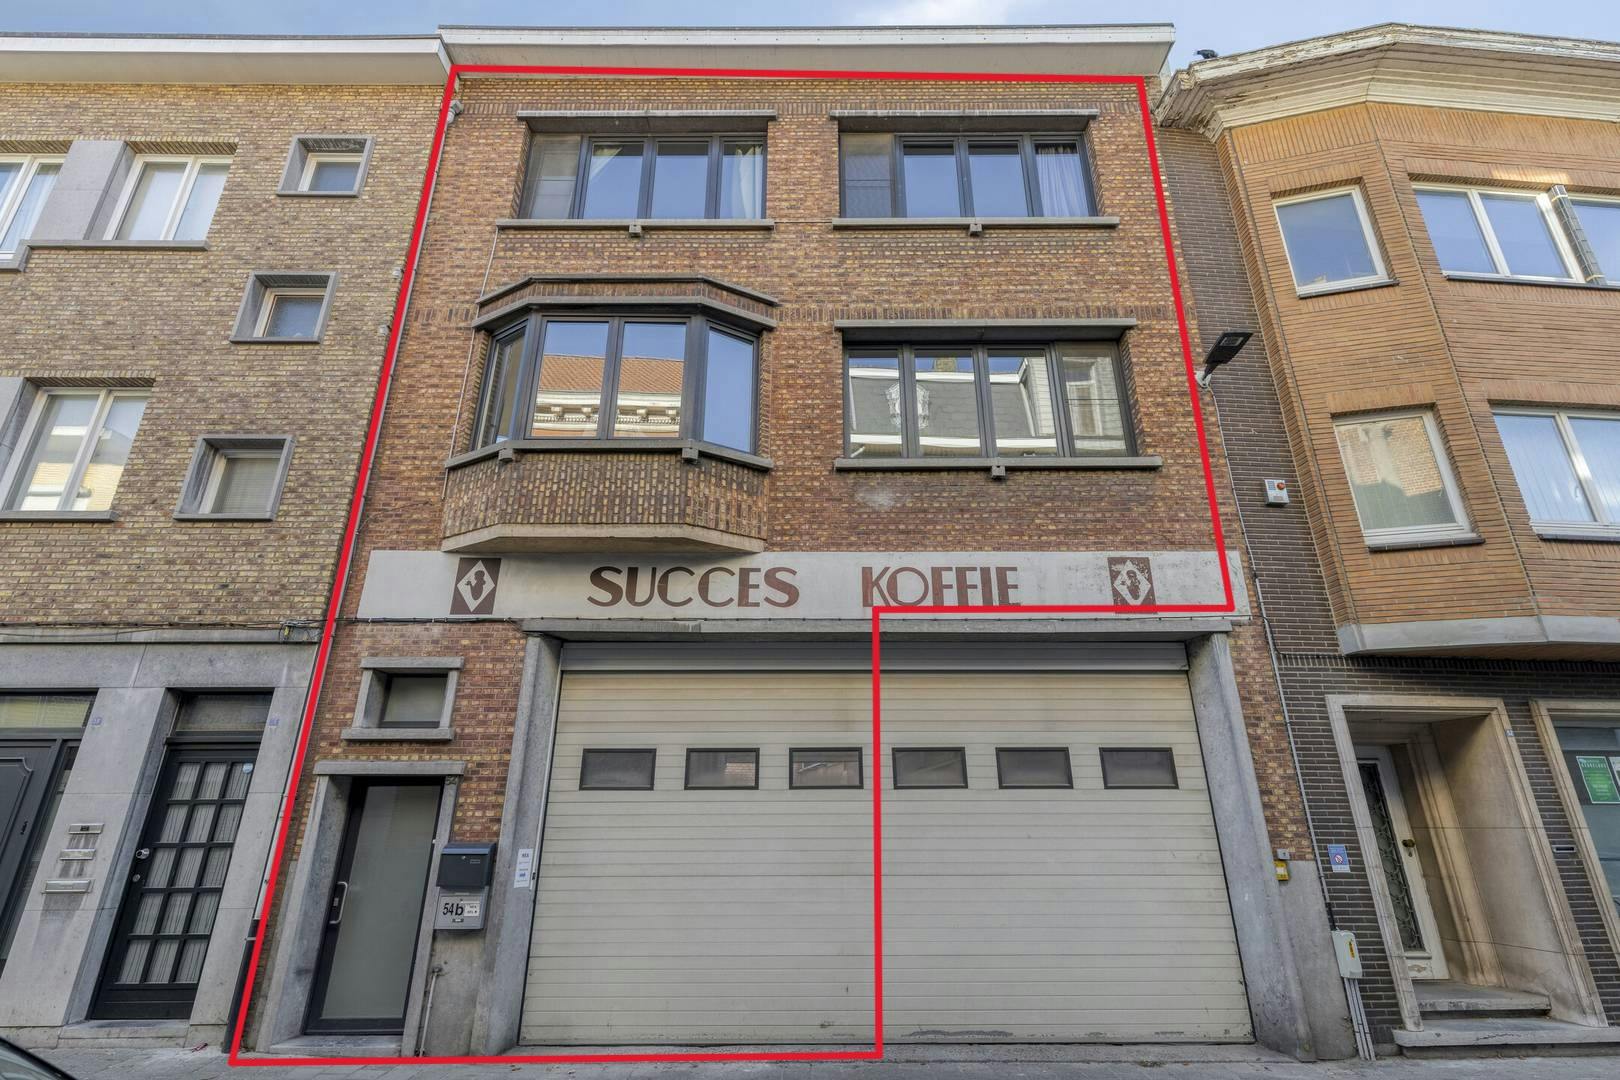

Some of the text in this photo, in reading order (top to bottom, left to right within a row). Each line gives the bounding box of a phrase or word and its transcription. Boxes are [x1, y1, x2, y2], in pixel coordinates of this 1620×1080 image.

[587, 566, 1021, 608] SUCCES KOFFIE
[442, 902, 464, 916] 54b
